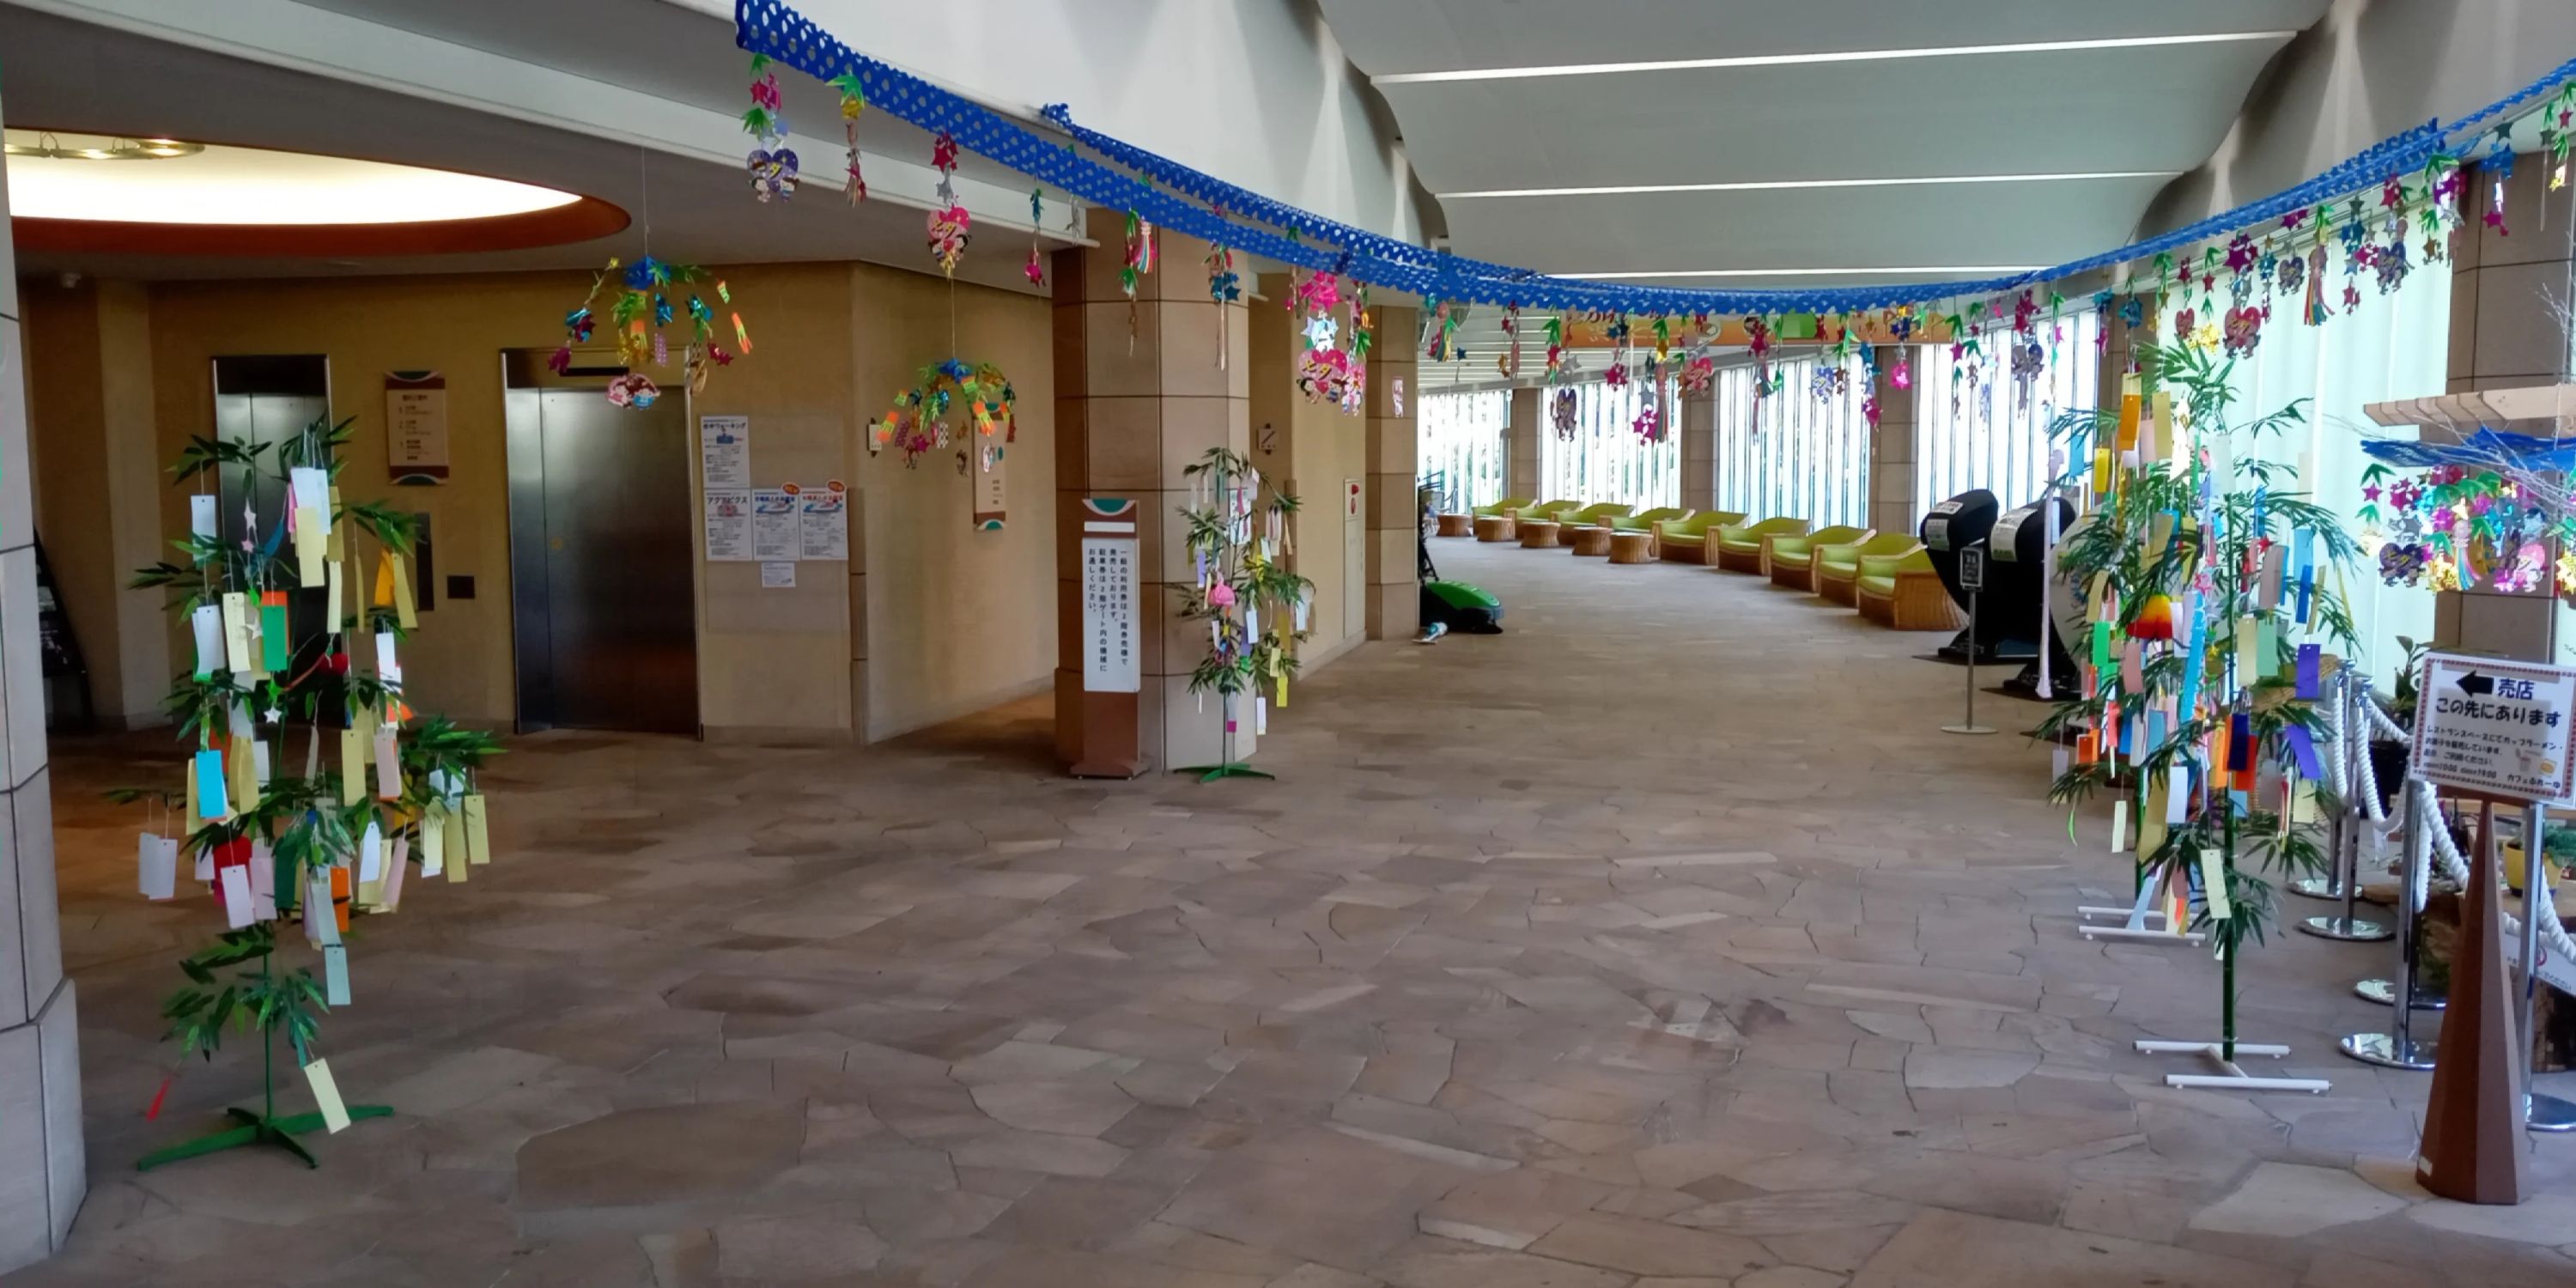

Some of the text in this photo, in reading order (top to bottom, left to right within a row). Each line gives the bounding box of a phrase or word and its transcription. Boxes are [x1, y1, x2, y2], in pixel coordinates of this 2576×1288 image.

[2498, 678, 2534, 701] 売店
[2436, 697, 2561, 728] この先にあります
